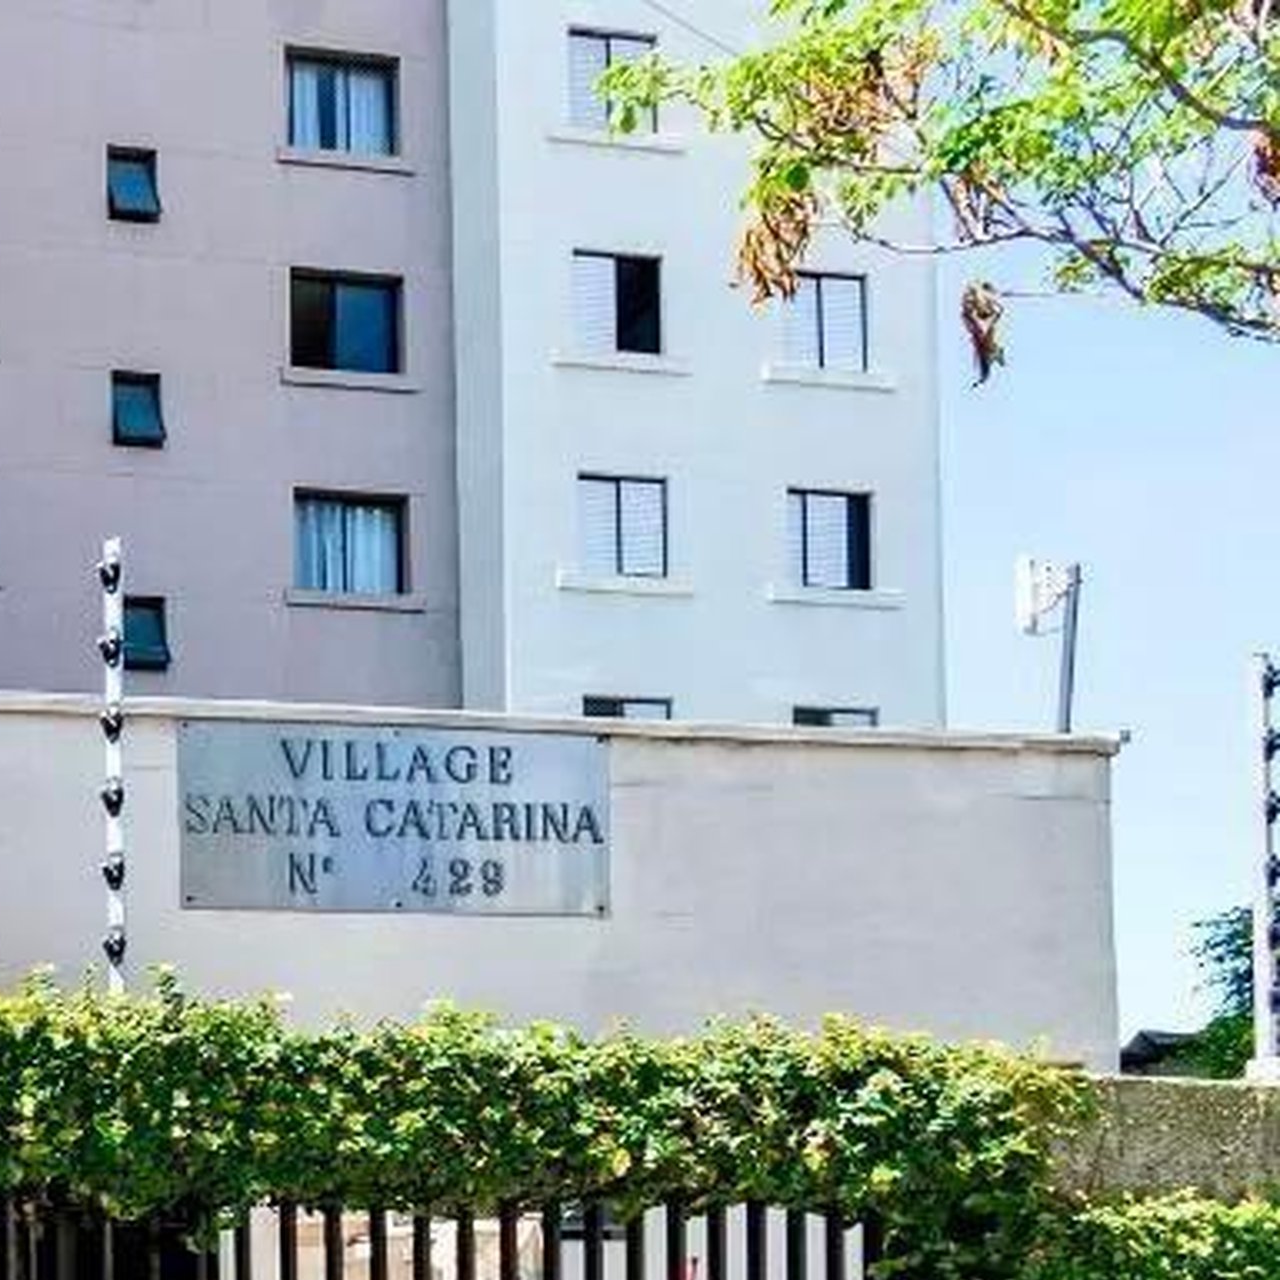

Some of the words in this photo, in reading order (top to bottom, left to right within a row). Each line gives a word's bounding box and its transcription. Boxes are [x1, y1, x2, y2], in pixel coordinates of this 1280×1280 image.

[280, 738, 514, 785] VILLAGE
[185, 793, 342, 838] SANTA
[365, 799, 605, 845] CATARINA
